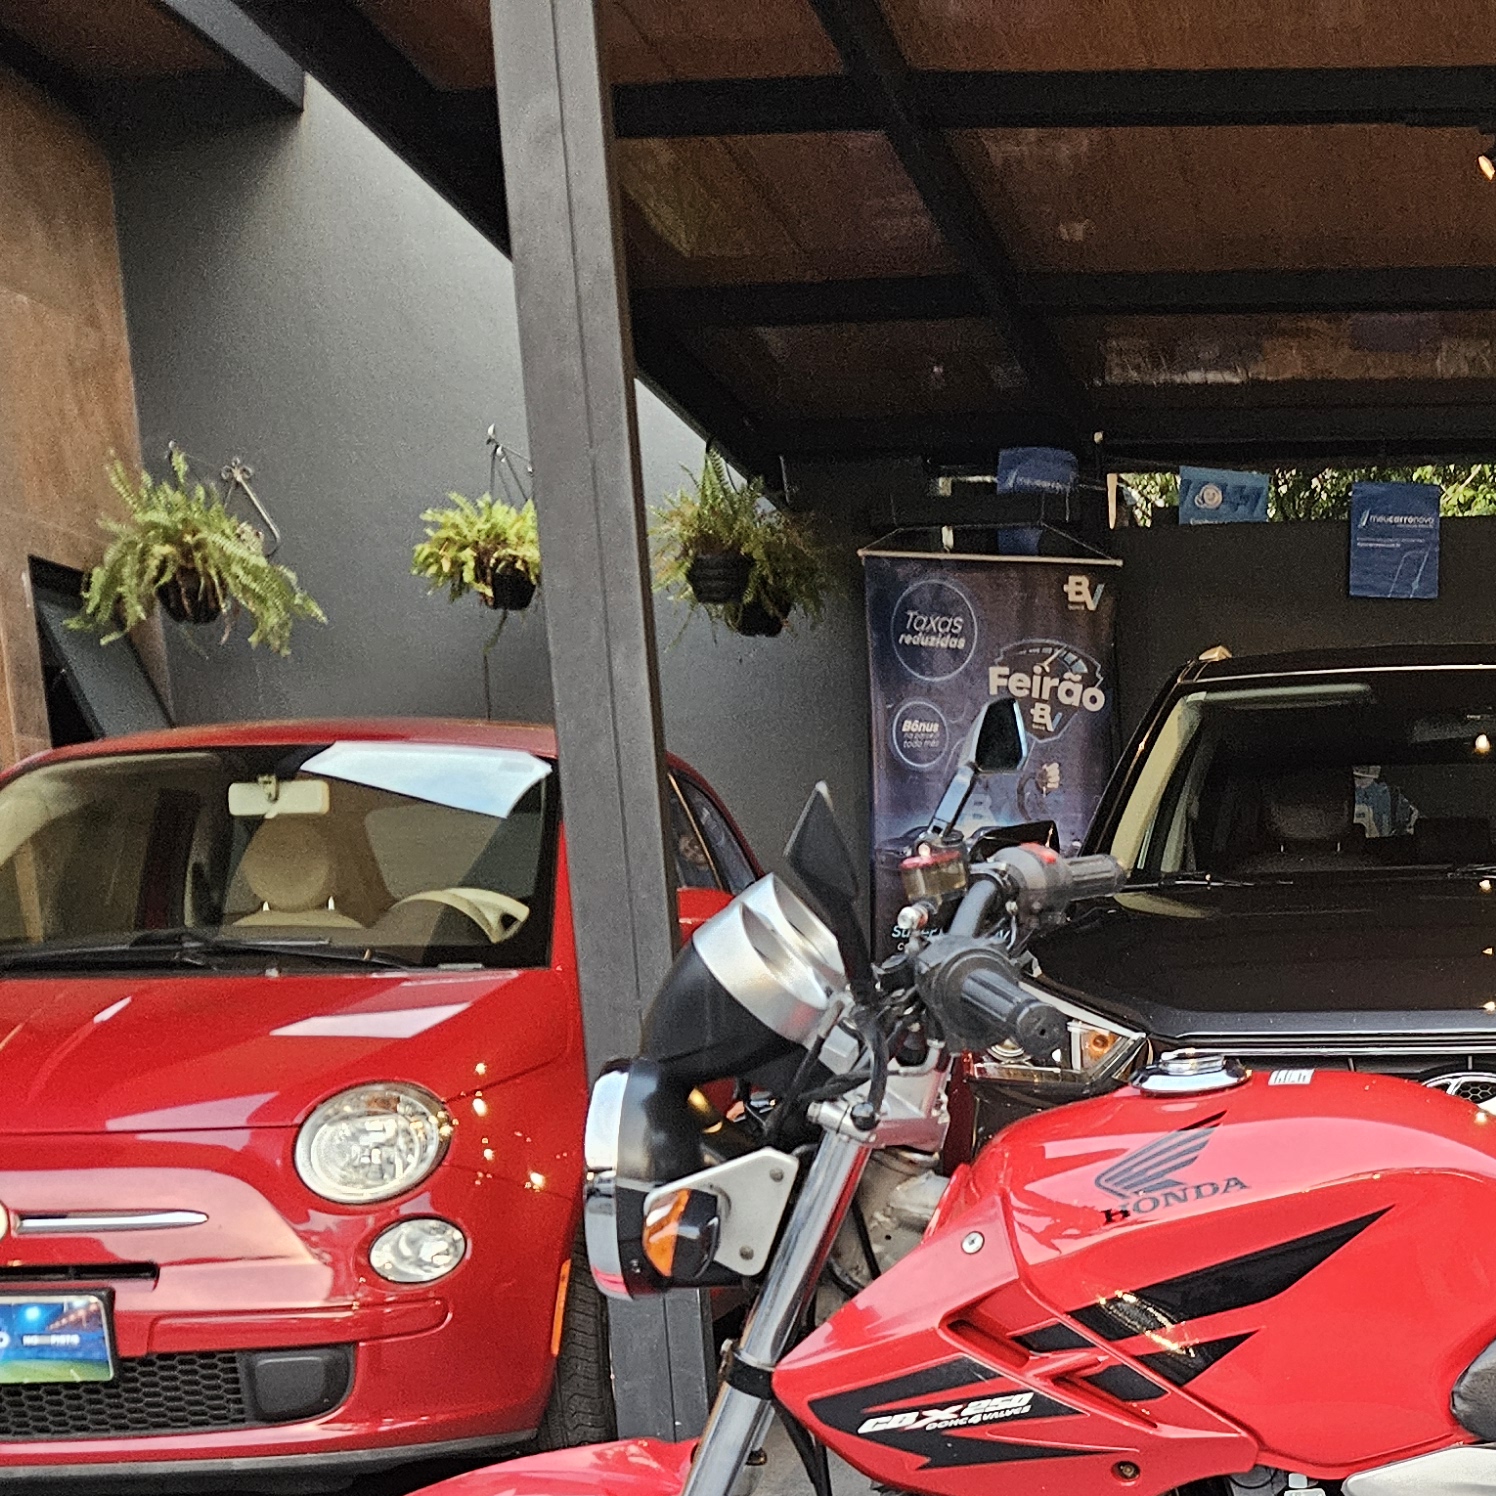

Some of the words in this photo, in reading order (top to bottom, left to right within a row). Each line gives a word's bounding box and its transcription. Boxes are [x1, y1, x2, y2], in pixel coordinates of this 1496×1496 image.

[905, 610, 964, 633] Taxas
[898, 631, 966, 649] reduzidas
[988, 663, 1106, 712] Feirão
[902, 720, 939, 733] Bônus
[1101, 1176, 1252, 1226] HONDA
[962, 1392, 1035, 1415] 250
[981, 1405, 1032, 1420] VALVES
